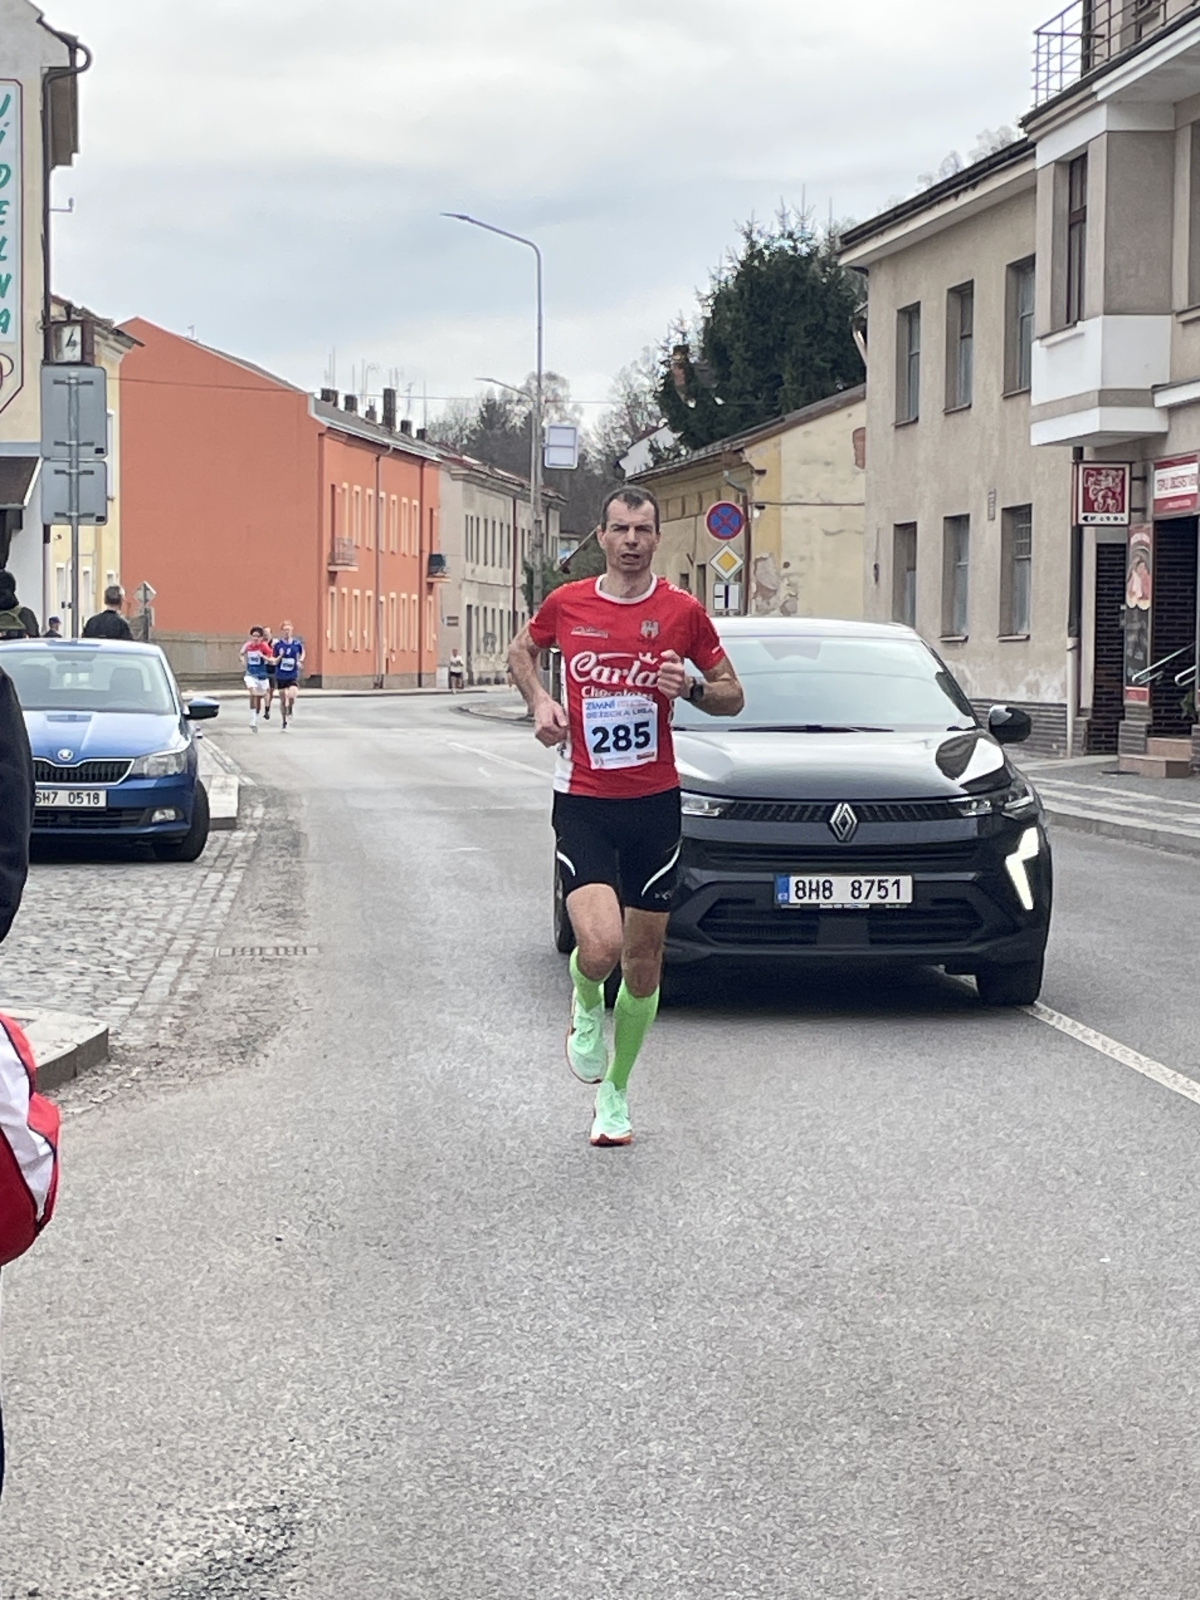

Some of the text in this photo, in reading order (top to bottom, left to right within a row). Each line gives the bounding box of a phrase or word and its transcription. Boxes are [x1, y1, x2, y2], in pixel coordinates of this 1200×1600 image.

[569, 650, 659, 688] Carla
[591, 721, 650, 754] 285
[68, 791, 100, 805] 0518
[794, 879, 901, 900] 8H8 8751
